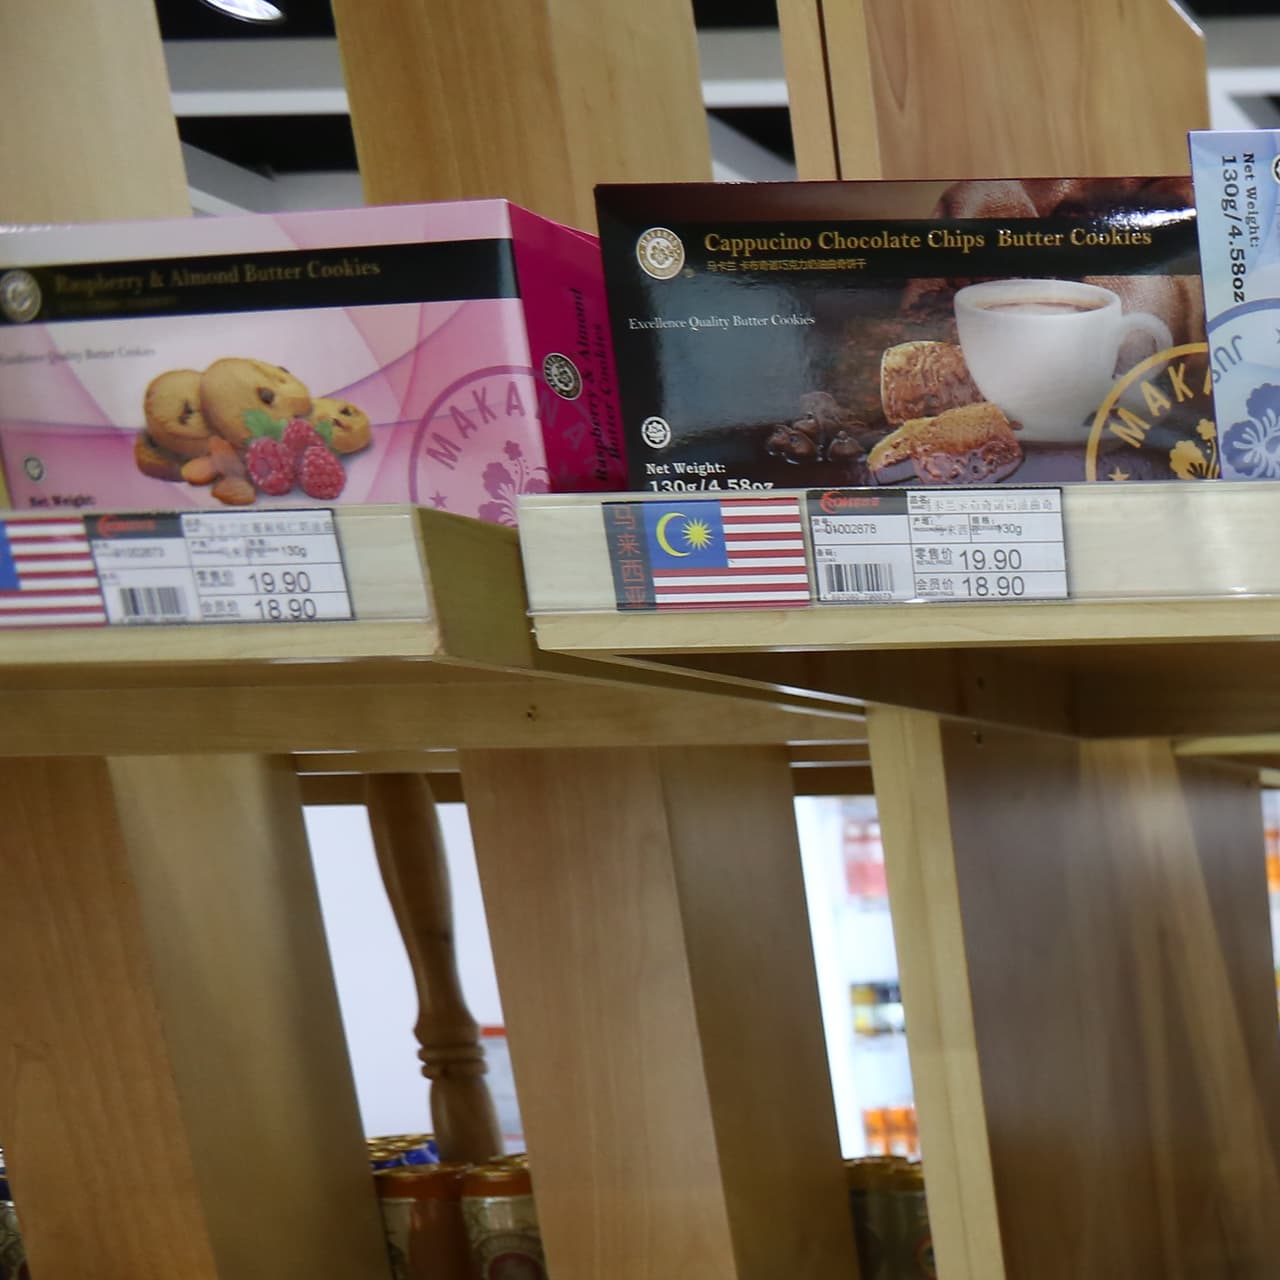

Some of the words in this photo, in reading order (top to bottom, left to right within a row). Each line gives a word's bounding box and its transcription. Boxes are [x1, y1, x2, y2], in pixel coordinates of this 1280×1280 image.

[1243, 153, 1256, 182] Net
[1221, 153, 1248, 303] 130g/4.58oz
[1245, 186, 1259, 248] Weight:
[704, 232, 812, 257] Cappucino
[818, 229, 921, 250] Chocolate
[927, 229, 984, 254] Chips
[997, 228, 1062, 248] Butter
[1070, 227, 1152, 247] Cookies
[171, 266, 240, 287] Almond
[243, 263, 303, 282] Butter
[307, 259, 381, 279] Cookies
[689, 315, 729, 331] Quality
[732, 314, 768, 327] Butter
[771, 313, 815, 327] Cookies
[646, 463, 671, 475] Net
[674, 462, 726, 477] Weight:
[611, 505, 647, 606] 马来西亚
[959, 549, 1023, 571] 19.90
[248, 572, 311, 593] 19.90
[962, 575, 1025, 597] 18.90
[254, 598, 317, 620] 18.90
